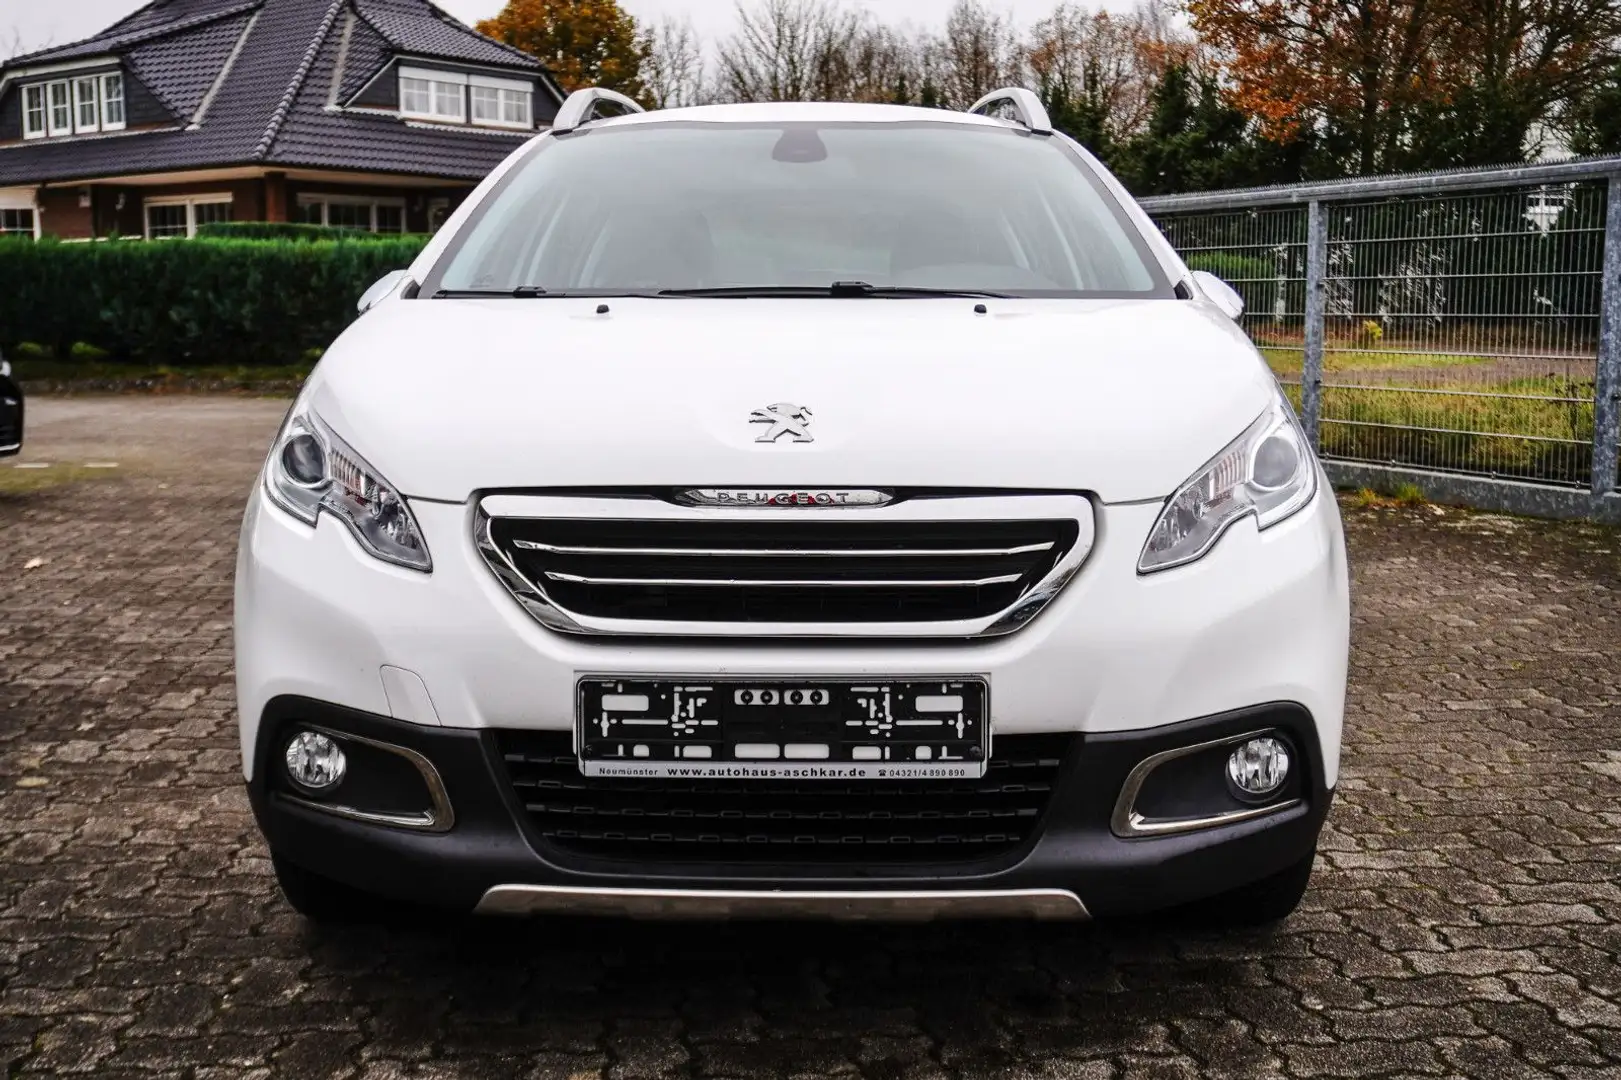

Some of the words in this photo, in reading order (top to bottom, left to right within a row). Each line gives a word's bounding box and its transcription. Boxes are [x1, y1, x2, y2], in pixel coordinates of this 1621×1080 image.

[717, 492, 849, 504] PEUGEOT
[599, 766, 658, 776] Neumünster
[667, 767, 867, 777] www.autohaus-aschkar.de
